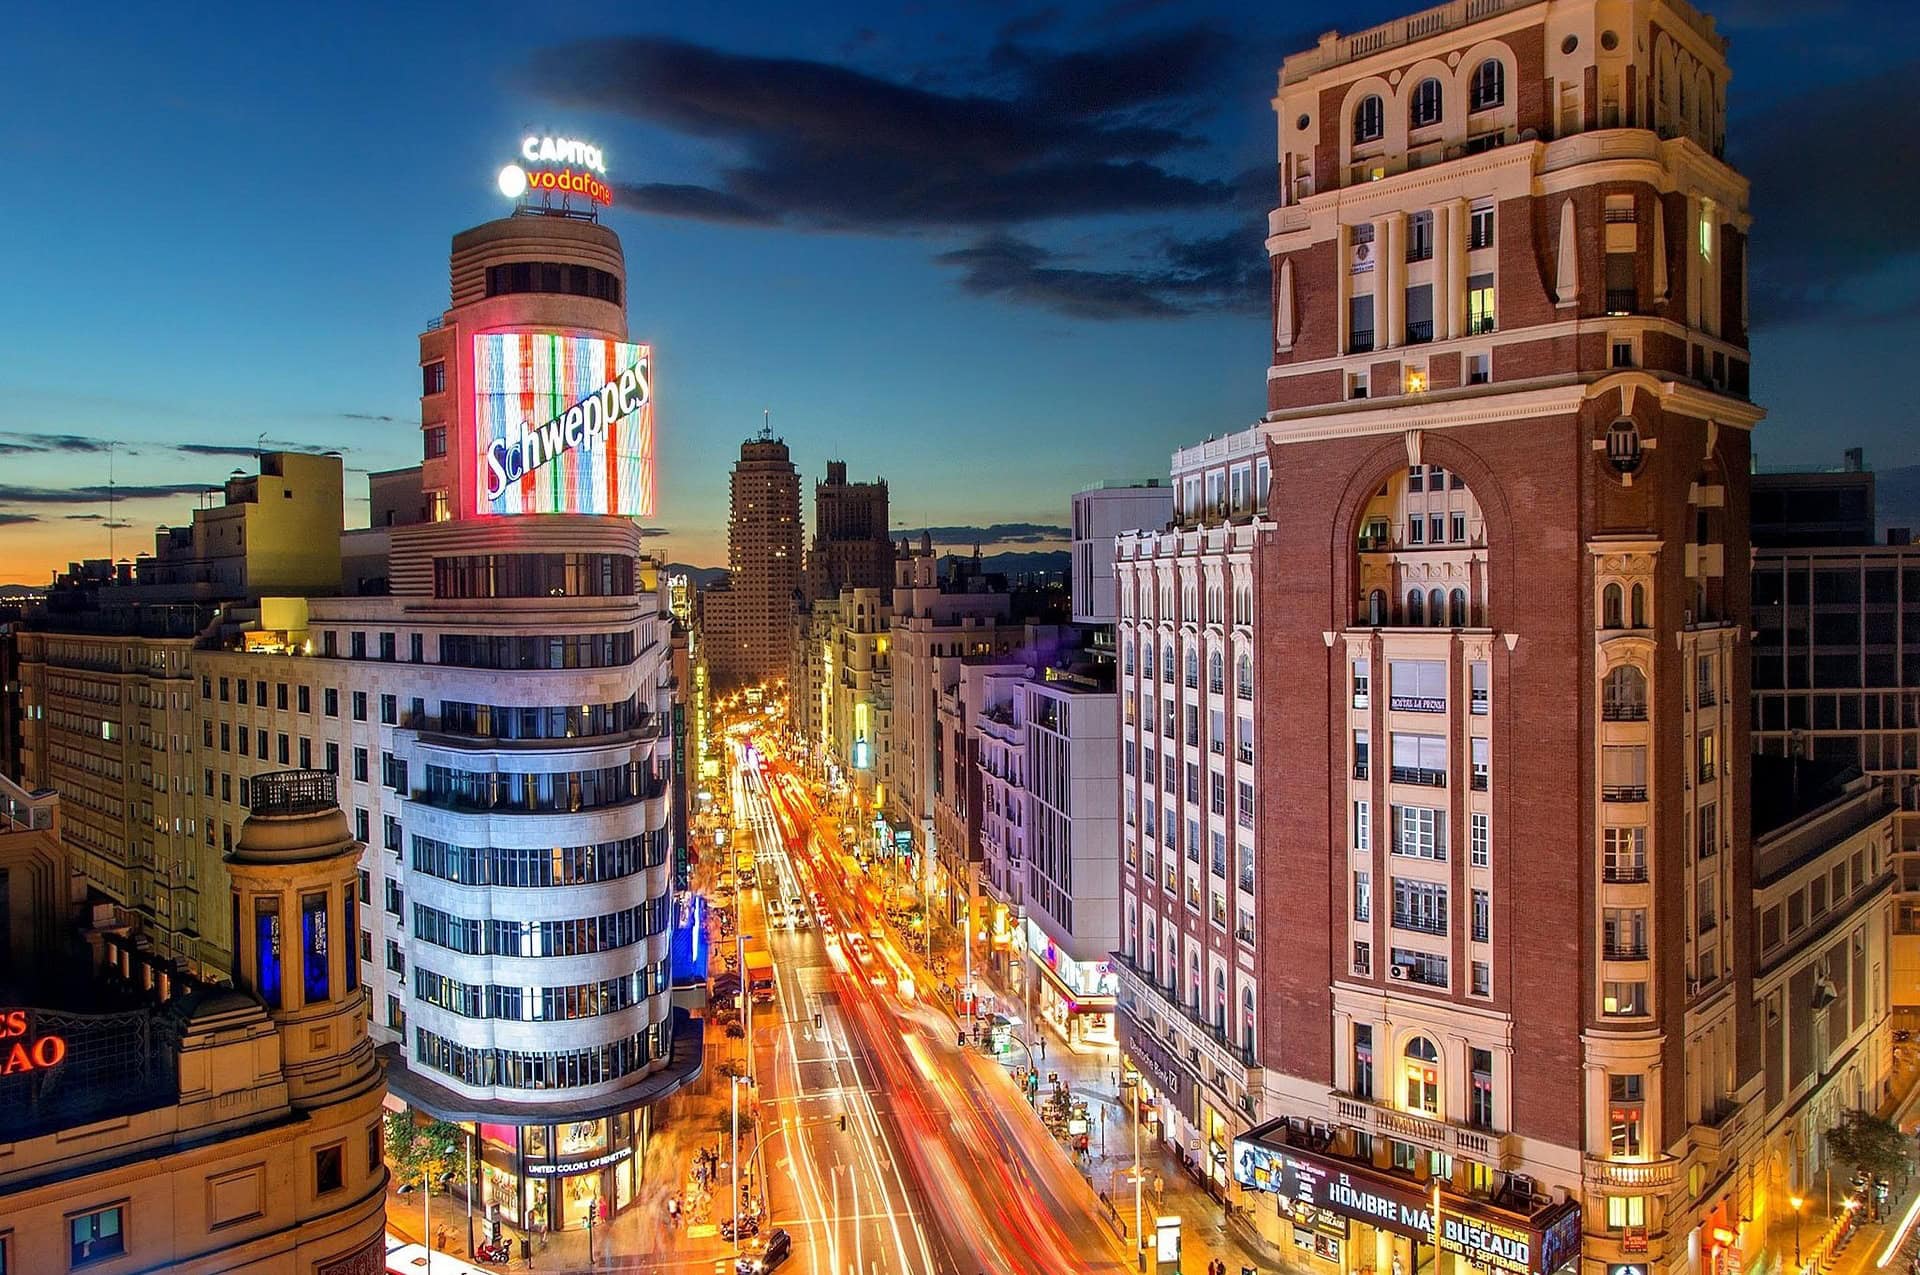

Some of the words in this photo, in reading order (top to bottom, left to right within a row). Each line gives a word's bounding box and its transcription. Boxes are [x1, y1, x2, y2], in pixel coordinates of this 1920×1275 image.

[523, 137, 606, 175] CAPITOL
[527, 169, 611, 207] vodafone
[488, 356, 649, 500] Schweppes
[675, 708, 684, 775] HOTEL
[677, 848, 687, 886] REX
[0, 1035, 65, 1075] AO
[528, 1165, 556, 1173] UNITED
[557, 1162, 588, 1173] COLORS
[589, 1158, 600, 1167] OF
[599, 1147, 632, 1165] BENETTON
[1339, 1173, 1350, 1187] EL
[1329, 1183, 1397, 1221] HOMBRE
[1400, 1206, 1441, 1233] MÁS
[1445, 1219, 1529, 1263] BUSCADO
[1476, 1250, 1529, 1275] SEPTIEMBRE
